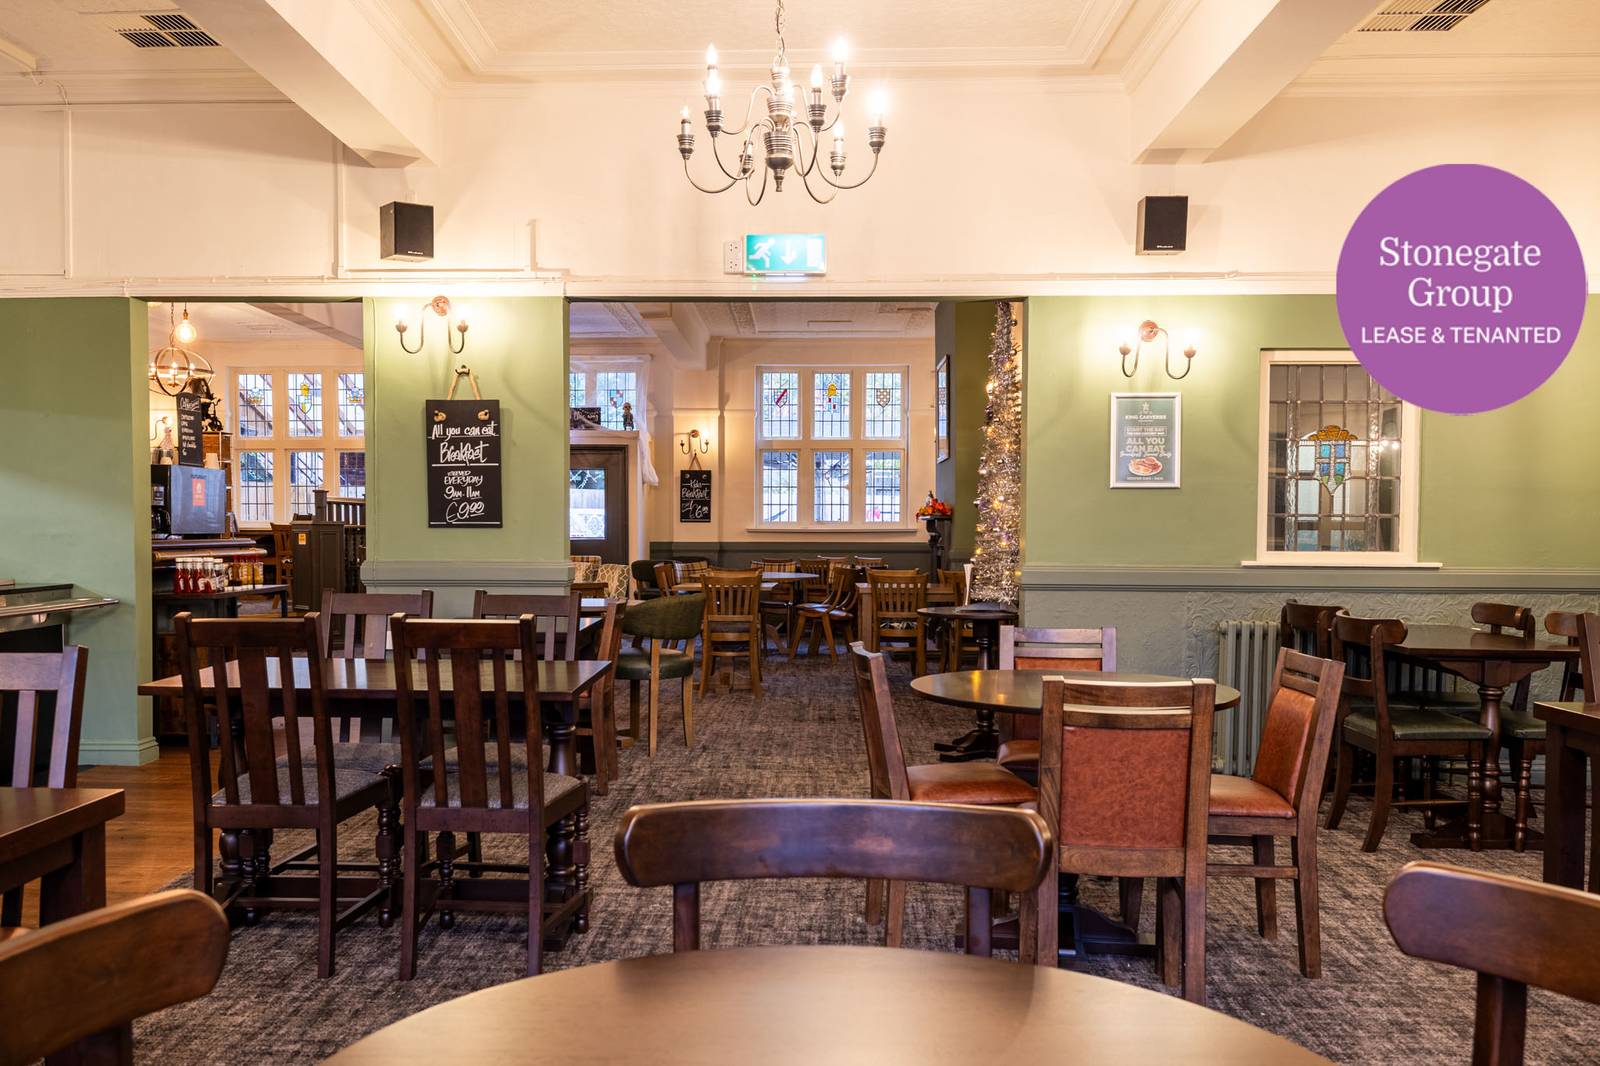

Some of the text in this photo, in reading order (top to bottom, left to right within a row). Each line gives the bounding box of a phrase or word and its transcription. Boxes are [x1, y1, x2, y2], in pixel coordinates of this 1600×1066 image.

[431, 420, 498, 441] All you can eat
[1126, 437, 1165, 445] ALL YOU
[440, 440, 490, 466] Breakfast
[1126, 445, 1166, 453] CAN EAT
